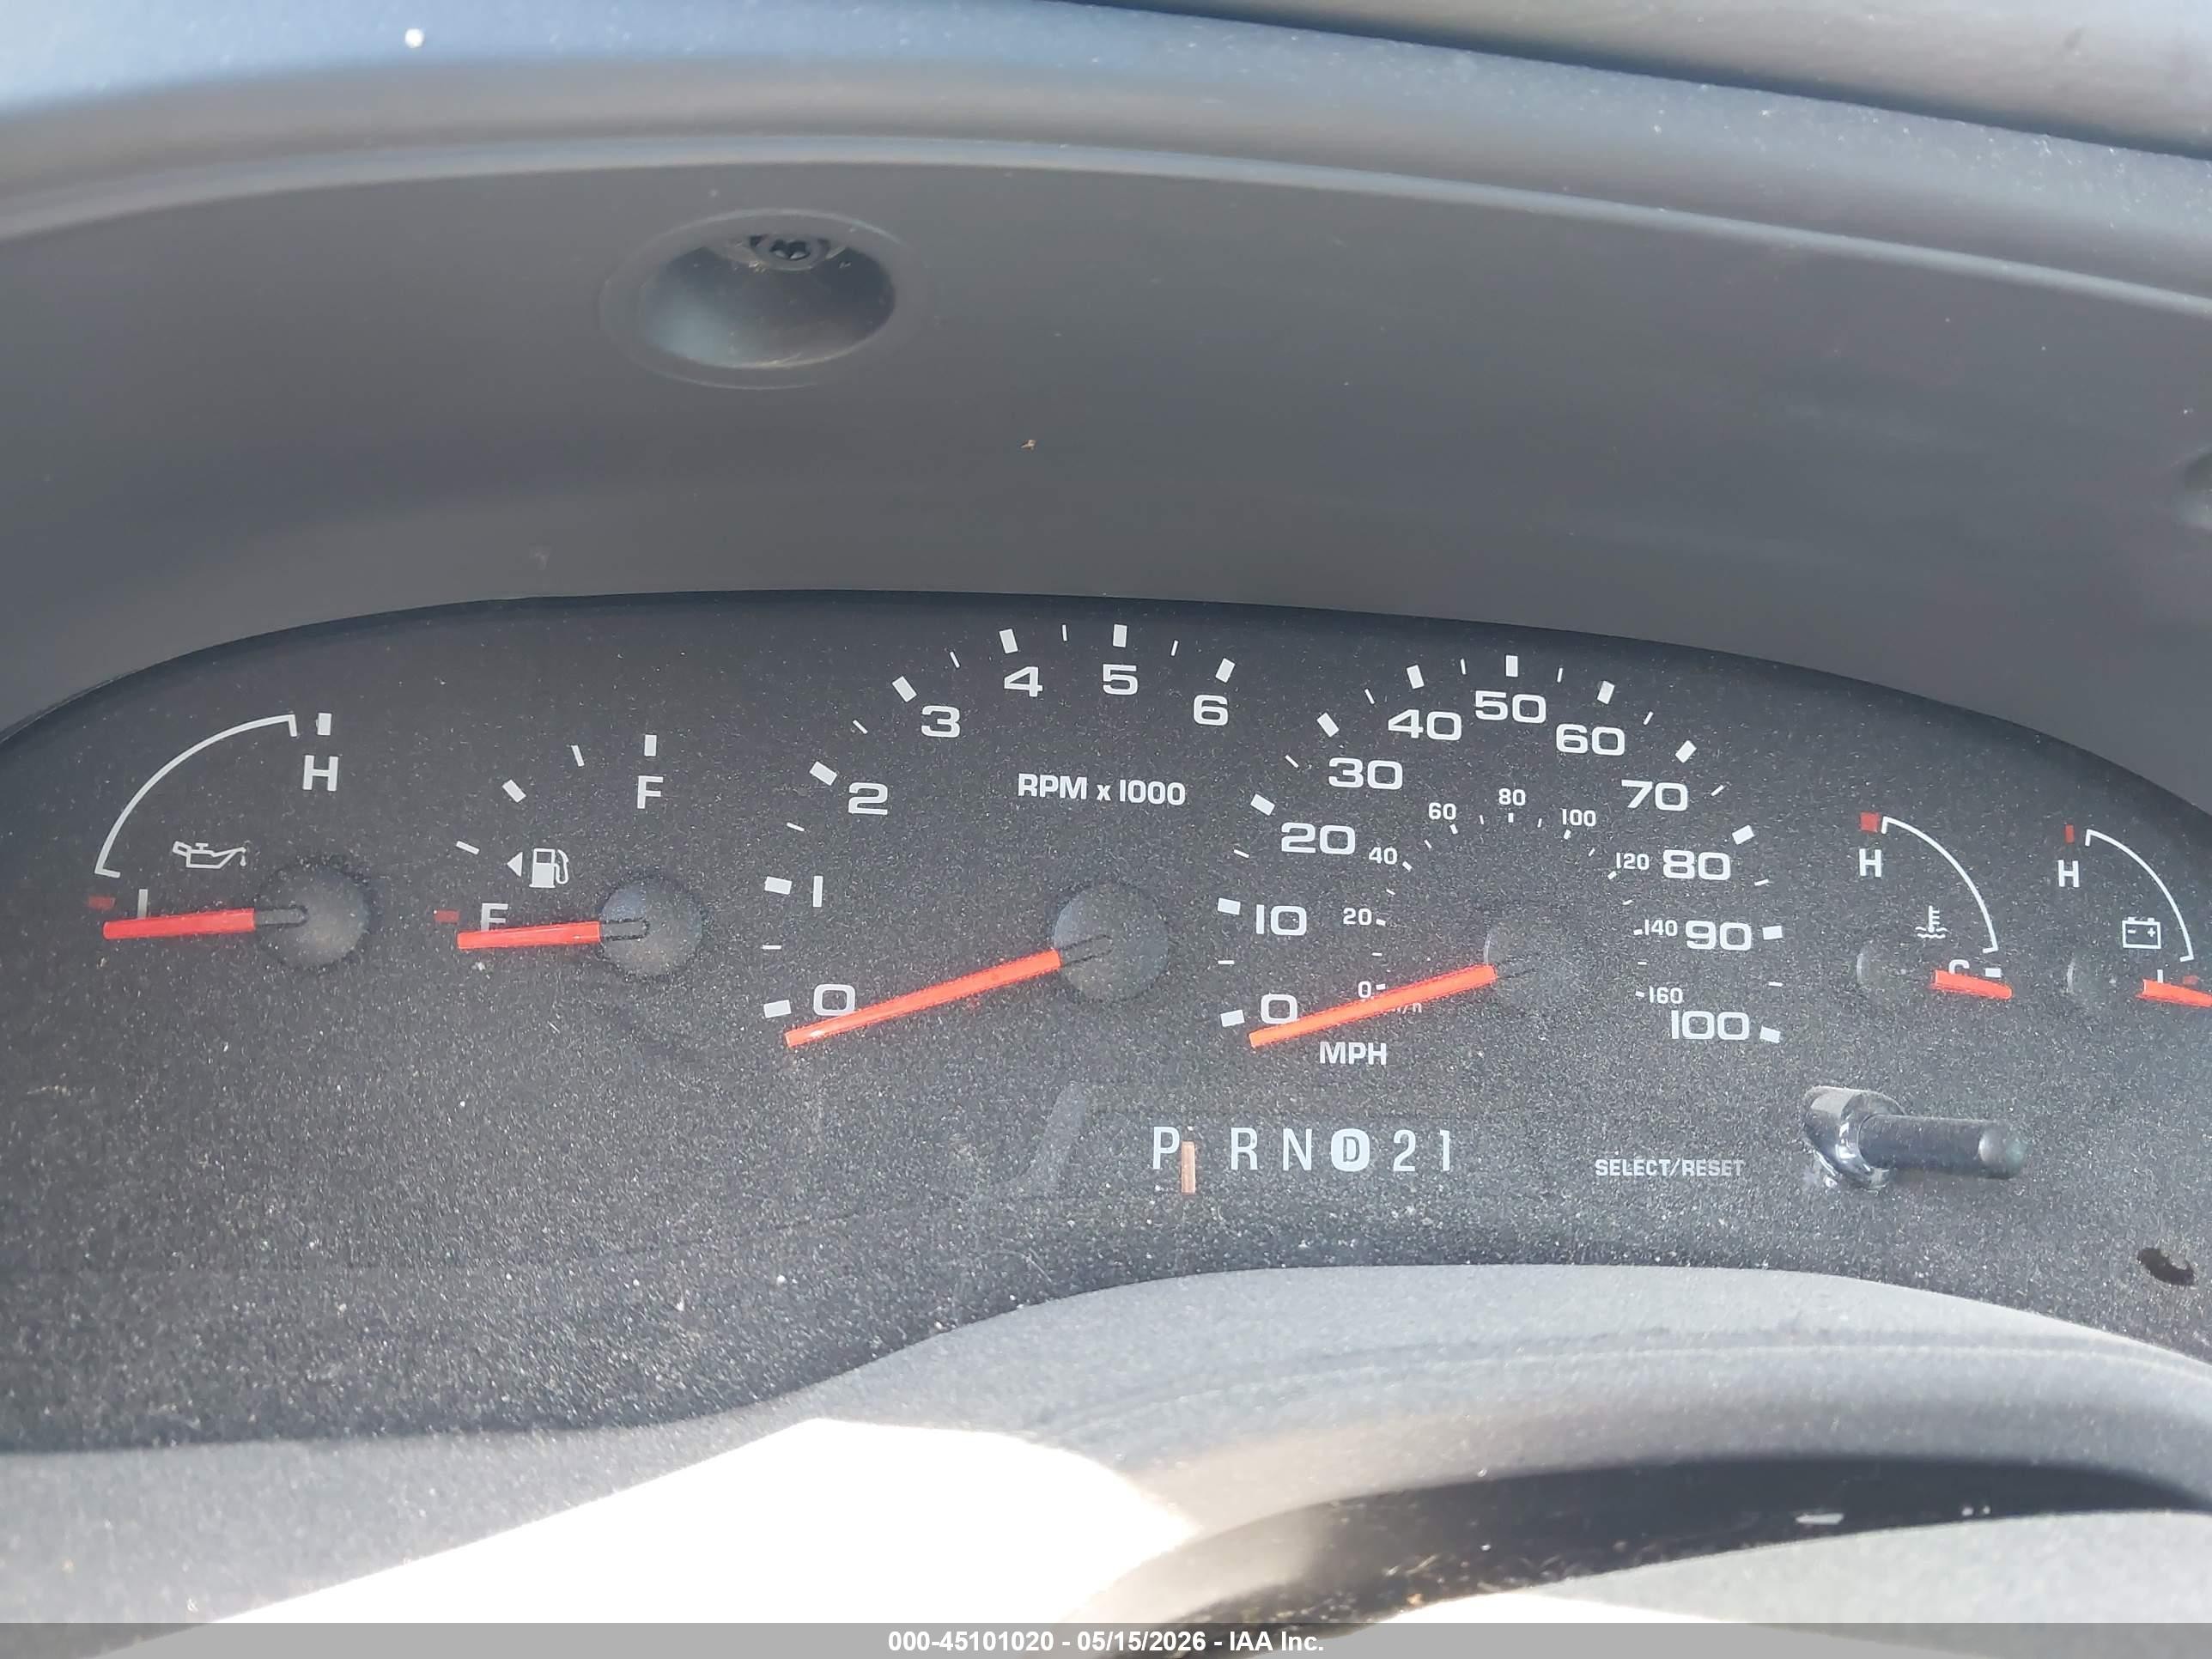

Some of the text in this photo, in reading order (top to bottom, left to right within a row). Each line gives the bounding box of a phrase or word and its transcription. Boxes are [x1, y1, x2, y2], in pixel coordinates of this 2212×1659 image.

[1005, 666, 1042, 696] 4
[1103, 664, 1138, 695] 5
[921, 706, 960, 738] 3
[1194, 695, 1228, 726] 6
[1475, 690, 1546, 723] 50
[1389, 709, 1462, 740] 40
[1557, 724, 1625, 756] 60
[303, 755, 338, 791] H
[1328, 757, 1402, 789] 30
[637, 775, 663, 809] F
[848, 782, 888, 815] 2
[1018, 774, 1185, 805] RPM x 1000
[1498, 788, 1526, 805] 80
[1621, 780, 1688, 811] 70
[1429, 802, 1456, 820] 60
[1561, 810, 1596, 827] 100
[1281, 823, 1355, 854] 20
[1369, 846, 1397, 865] 40
[1616, 853, 1650, 871] 120
[1663, 848, 1731, 881] 80
[1859, 848, 1883, 877] H
[2057, 860, 2079, 887] H
[813, 876, 823, 907] 1
[1256, 904, 1309, 936] 10
[1343, 908, 1371, 926] 20
[1644, 919, 1678, 937] 140
[1686, 921, 1751, 951] 90
[812, 984, 856, 1017] 0
[1358, 981, 1371, 998] 0
[1649, 987, 1683, 1005] 160
[1261, 994, 1298, 1024] 0
[1669, 1010, 1749, 1041] 100
[1320, 1041, 1388, 1066] MPH
[1152, 1126, 1180, 1170] P
[1231, 1127, 1258, 1170] R
[1283, 1127, 1313, 1171] N
[1393, 1129, 1417, 1172] 2
[1439, 1129, 1451, 1171] 1
[1595, 1158, 1745, 1177] SELECT/RESET
